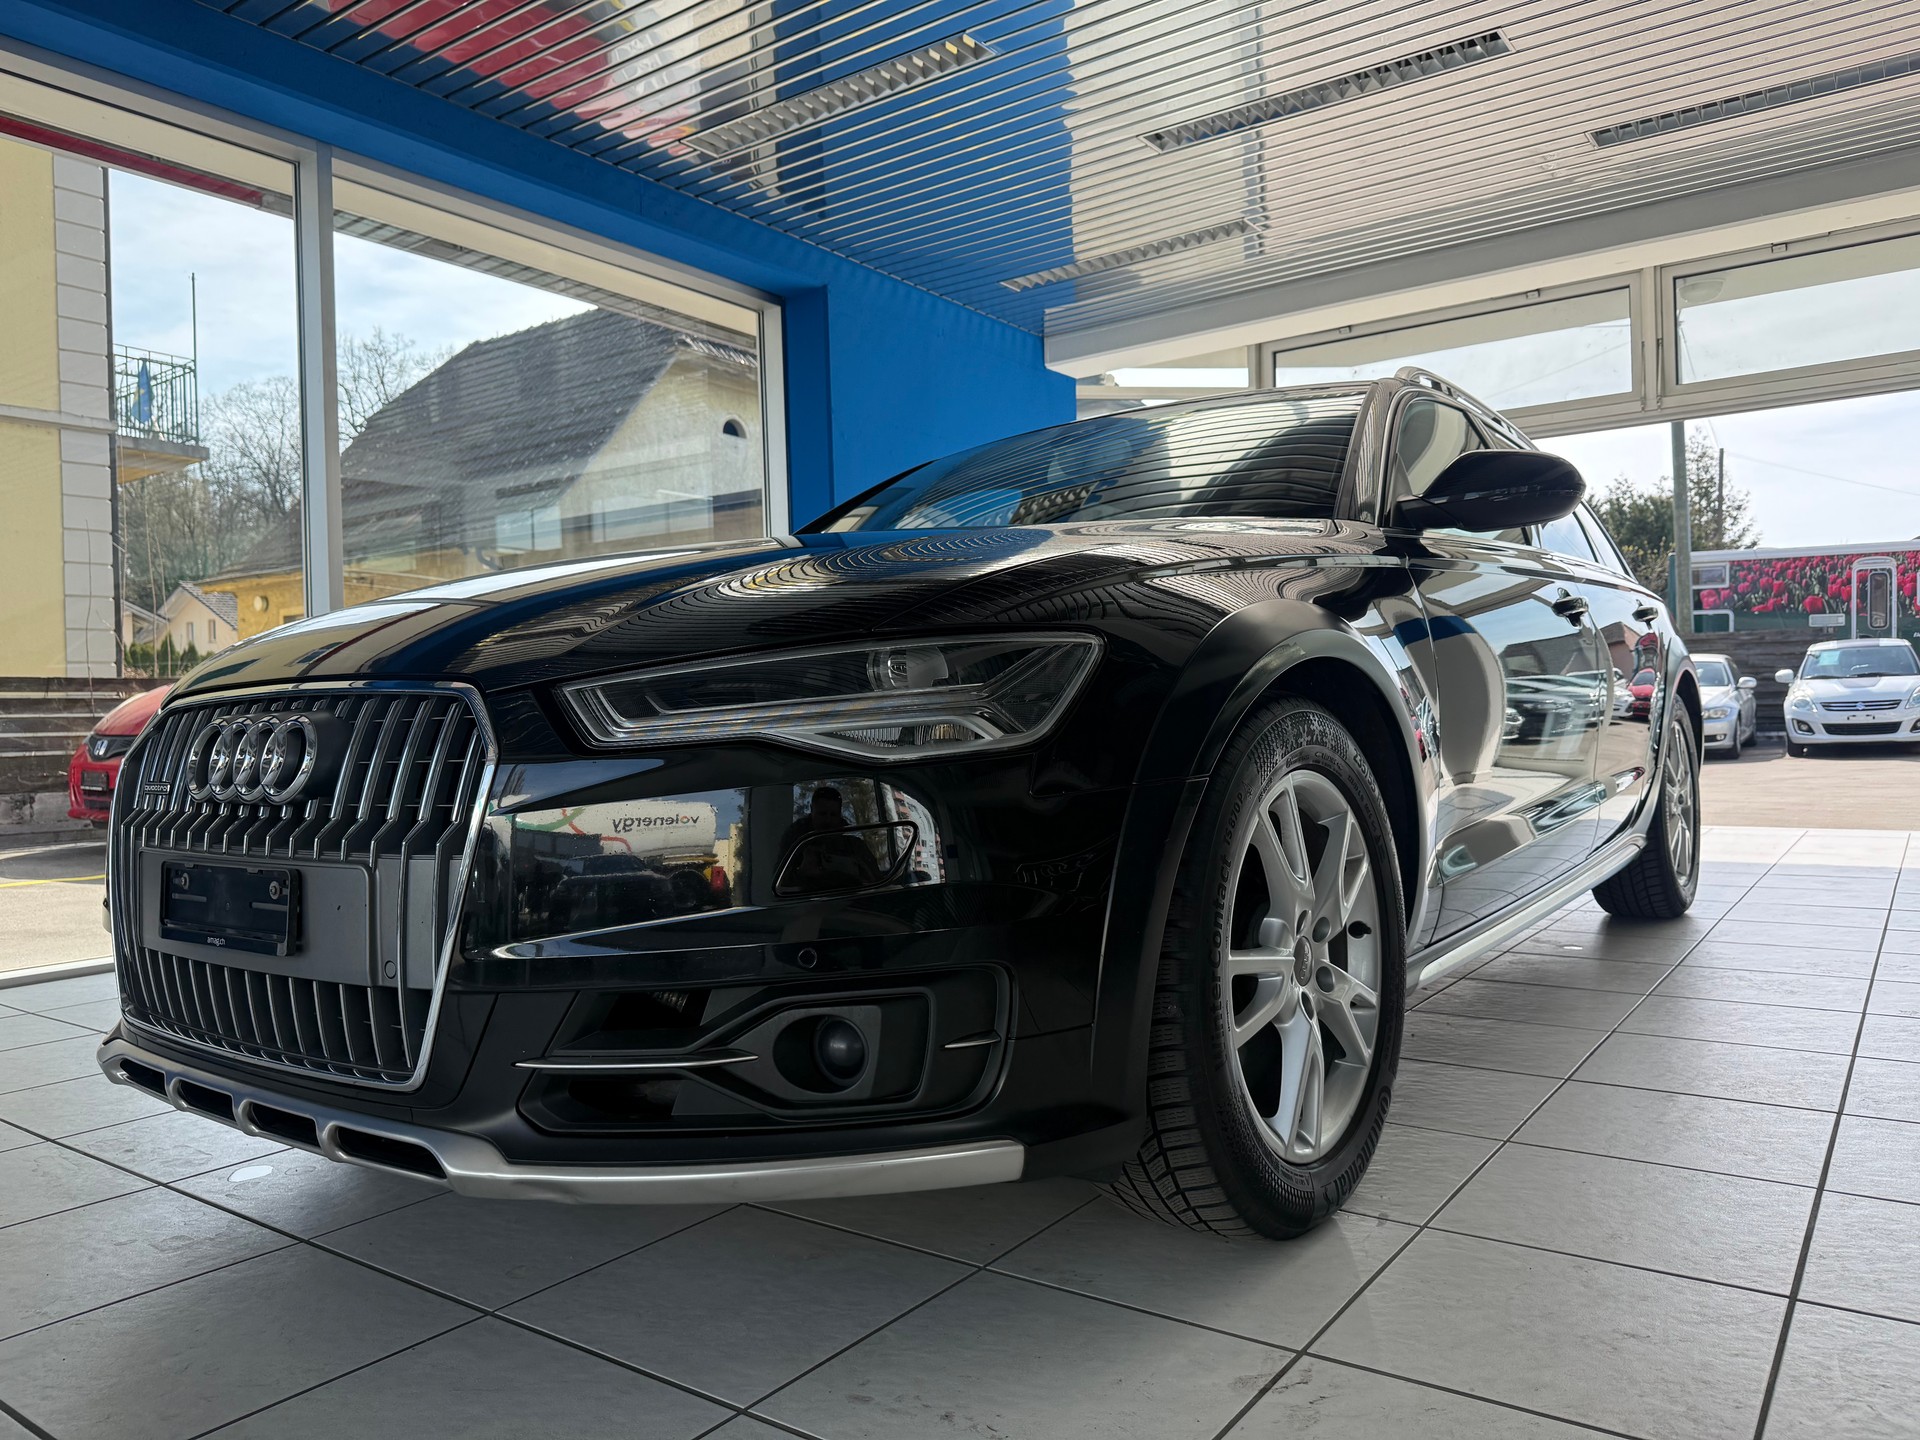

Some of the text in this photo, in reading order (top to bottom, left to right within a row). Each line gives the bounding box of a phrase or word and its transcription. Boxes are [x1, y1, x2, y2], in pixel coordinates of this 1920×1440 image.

[144, 784, 168, 792] quattro
[207, 936, 226, 947] amag.ch
[1208, 854, 1231, 1071] WinterContact
[1334, 1086, 1391, 1206] Continental
